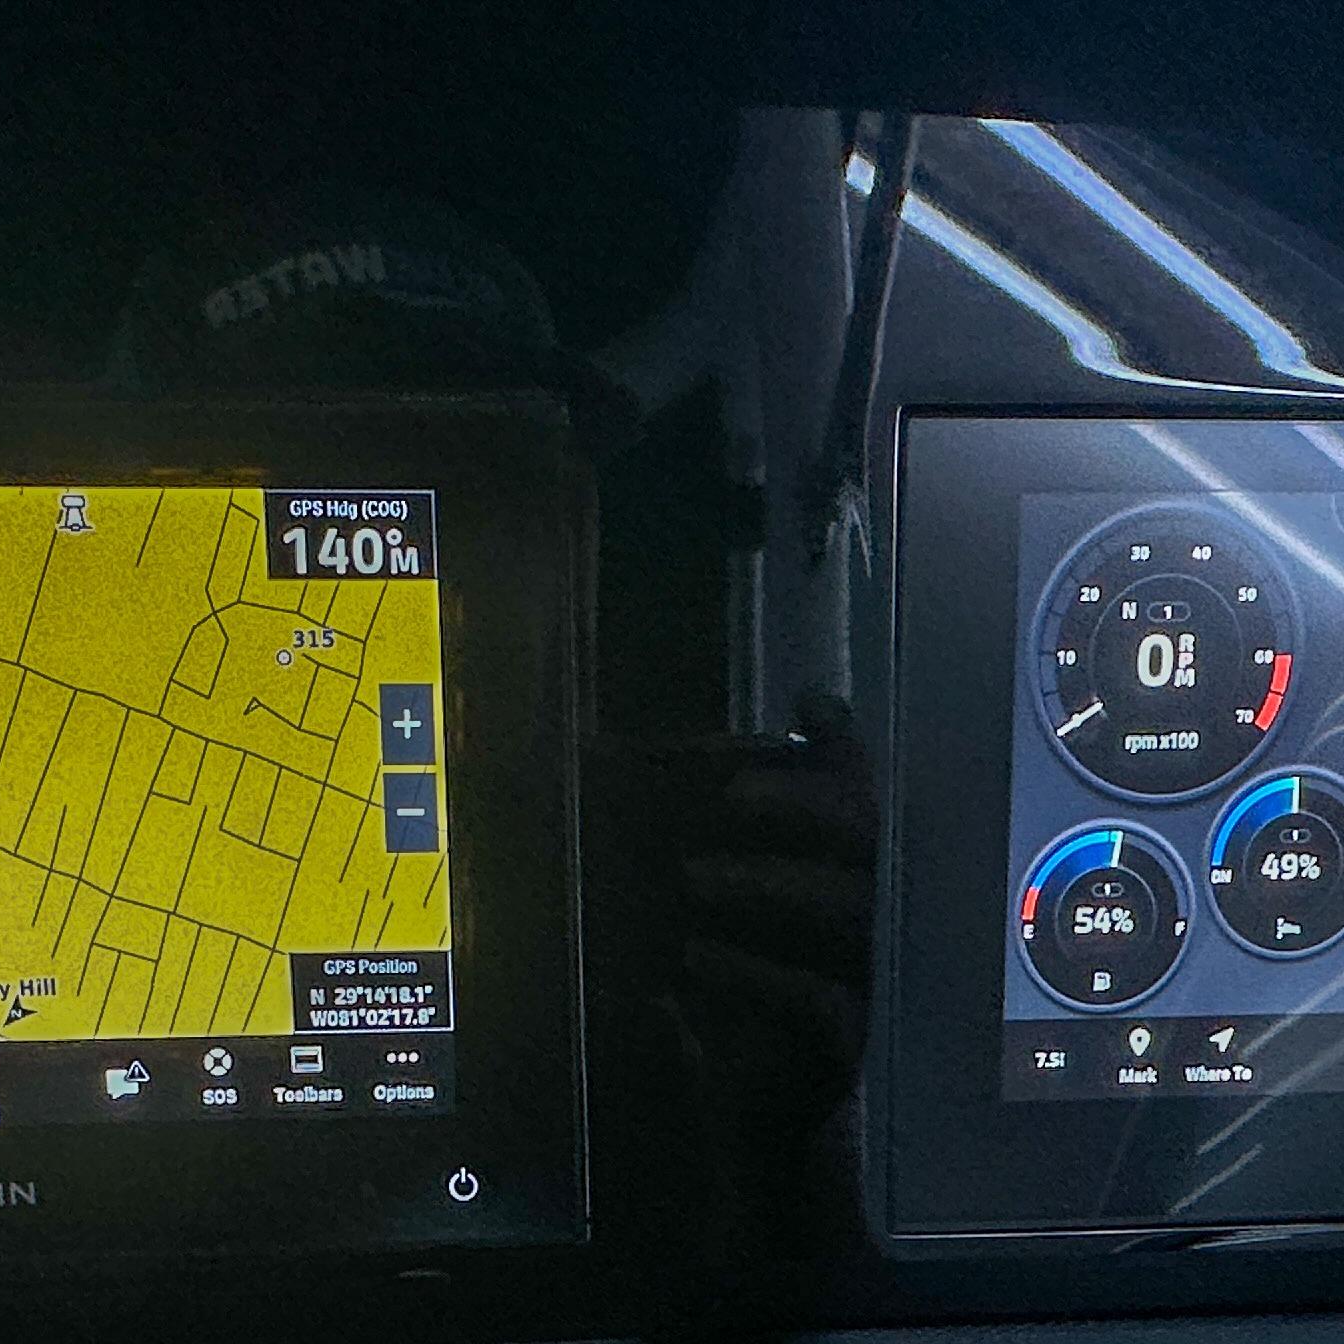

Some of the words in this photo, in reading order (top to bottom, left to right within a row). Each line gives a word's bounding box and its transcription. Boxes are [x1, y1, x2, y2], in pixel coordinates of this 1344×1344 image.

[290, 501, 324, 518] GPS
[327, 500, 358, 520] Hdg
[361, 500, 409, 521] (COG)
[1130, 545, 1151, 561] 30
[1192, 545, 1212, 561] 40
[1080, 587, 1100, 602] 20
[1238, 586, 1258, 602] 50
[1121, 602, 1137, 620] N
[1162, 605, 1173, 620] 1
[293, 629, 336, 649] 315
[1057, 650, 1076, 666] 10
[1137, 633, 1174, 688] 0
[1235, 709, 1255, 724] 70
[1124, 735, 1158, 754] rpm
[1159, 732, 1200, 750] x100
[1260, 852, 1322, 881] 49%
[1073, 906, 1135, 935] 54%
[323, 959, 356, 975] GPS
[358, 958, 418, 975] Position
[19, 978, 57, 997] Hill
[309, 987, 326, 1006] N
[1232, 1065, 1253, 1082] To
[202, 1087, 238, 1106] SOS
[273, 1085, 344, 1105] Toolbars
[373, 1083, 435, 1104] Options
